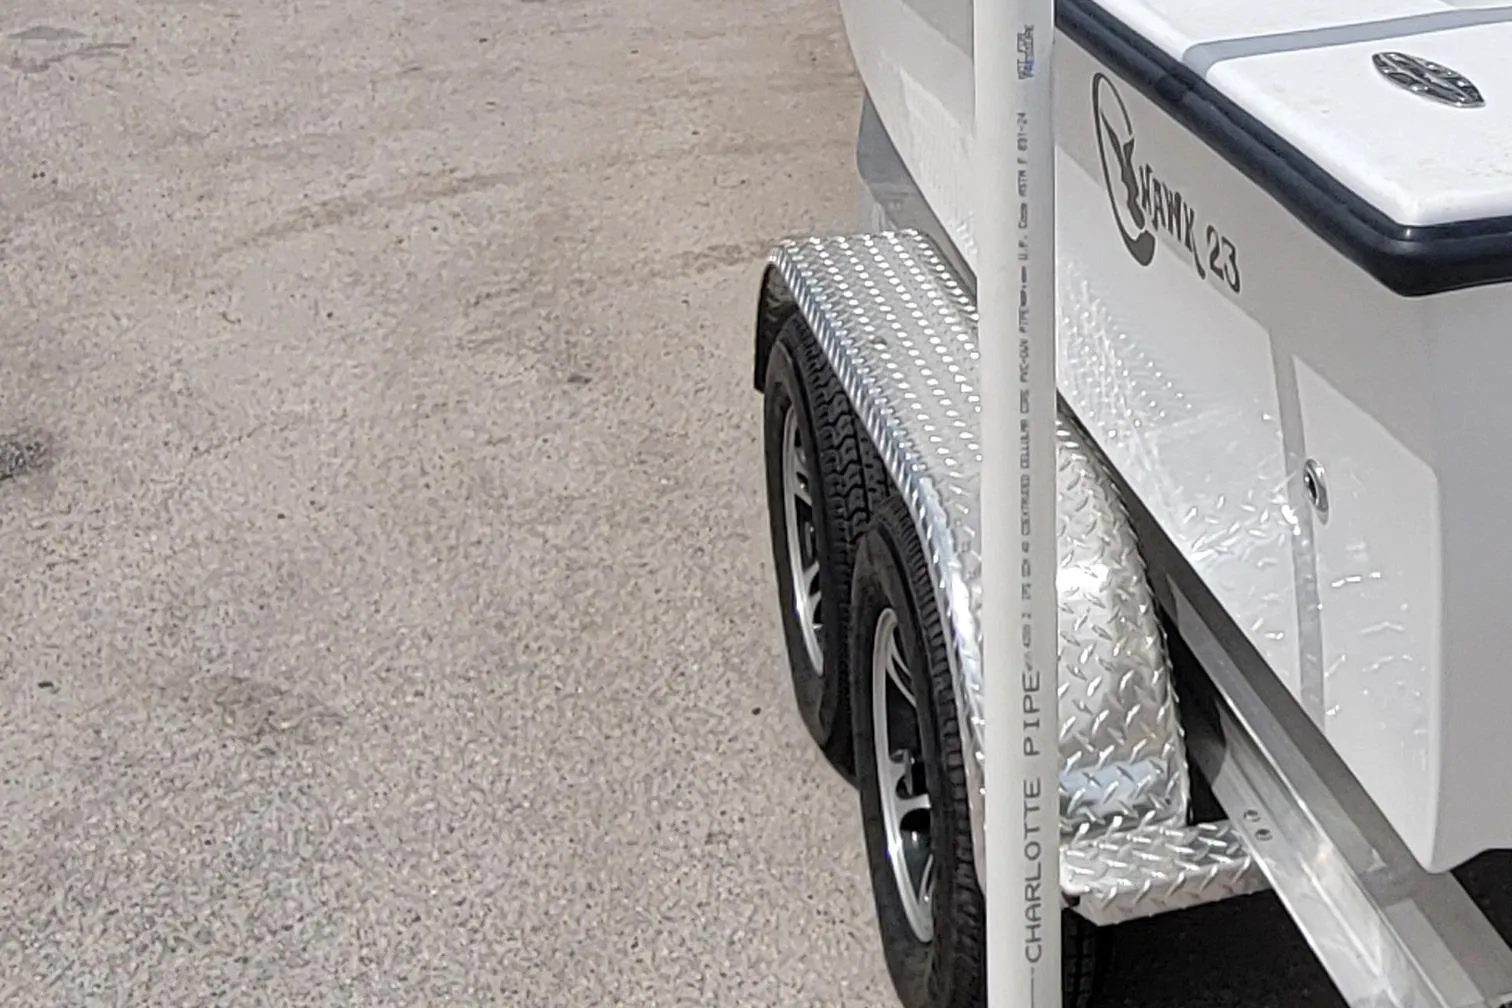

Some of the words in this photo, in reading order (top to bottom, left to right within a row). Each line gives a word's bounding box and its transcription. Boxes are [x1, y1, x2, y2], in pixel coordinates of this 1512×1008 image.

[1206, 224, 1241, 294] 23
[1022, 670, 1040, 756] PIPE
[1024, 777, 1042, 962] CHARLOTTE
